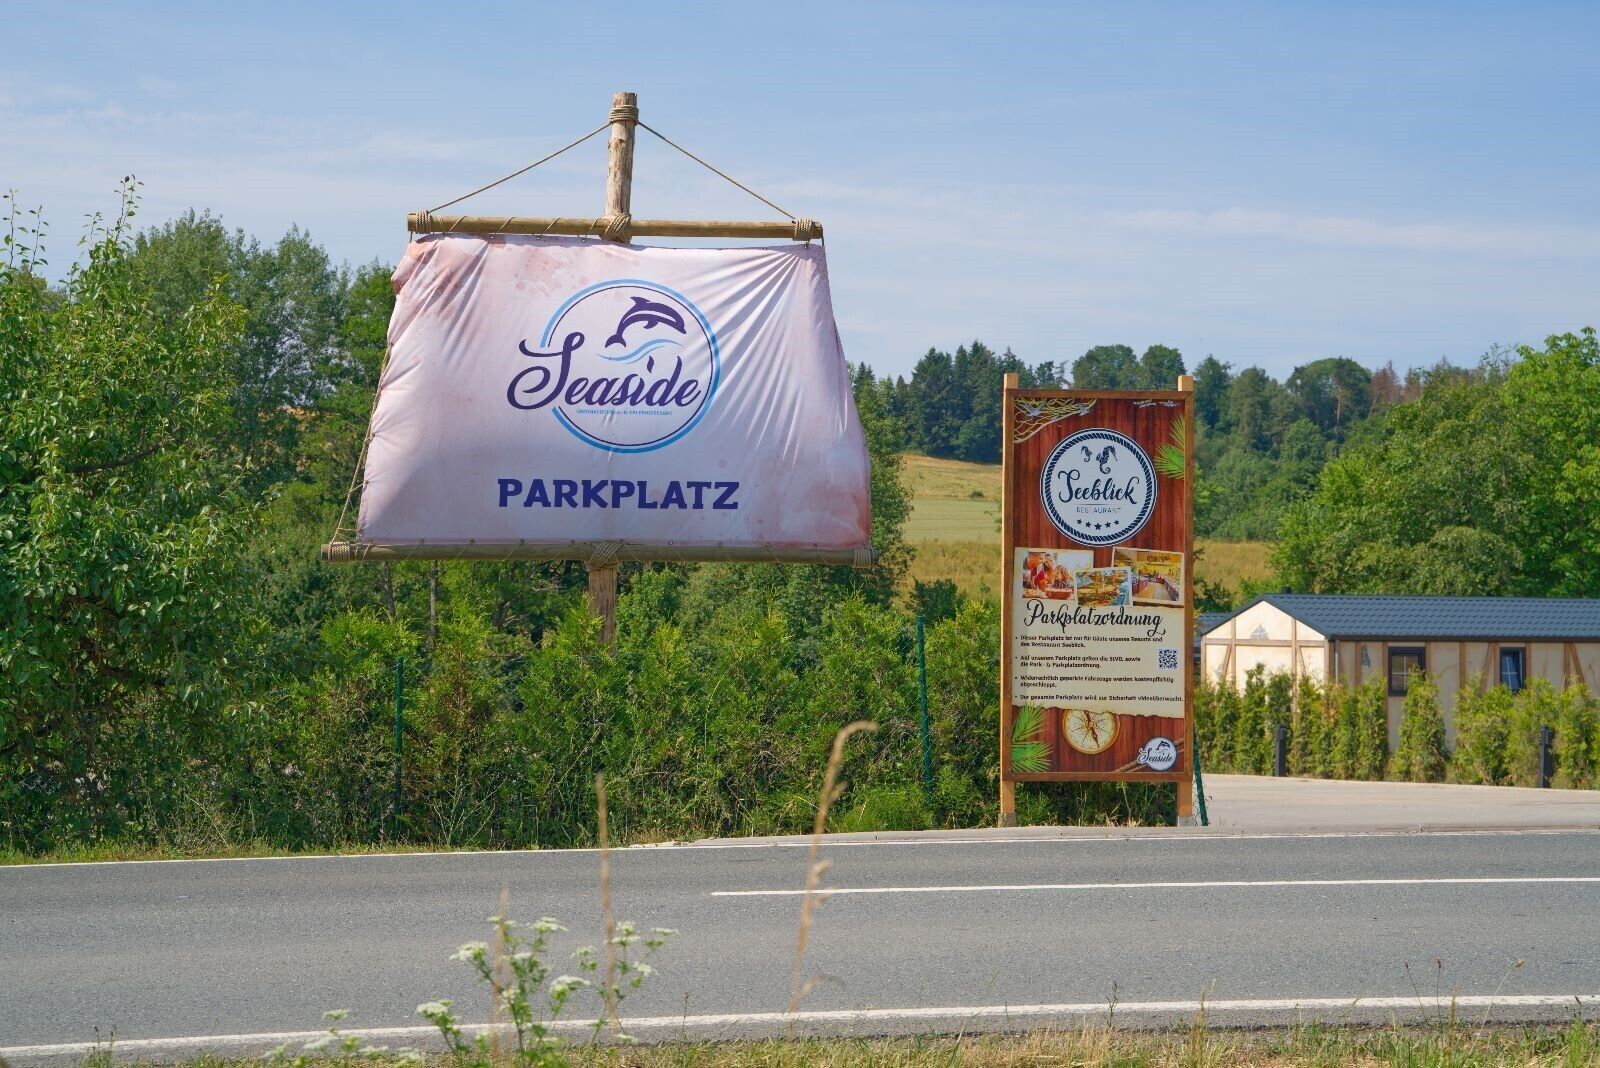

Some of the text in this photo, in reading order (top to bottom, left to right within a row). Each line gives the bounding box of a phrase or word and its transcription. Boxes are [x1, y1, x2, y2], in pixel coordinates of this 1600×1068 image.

[506, 337, 702, 410] Seaside
[497, 478, 740, 510] PARKPLATZ
[1057, 469, 1140, 505] Seeblick
[1076, 506, 1122, 514] RESTAURANT
[1023, 598, 1166, 637] Parkplatzordnung
[1138, 747, 1173, 764] Seaside
